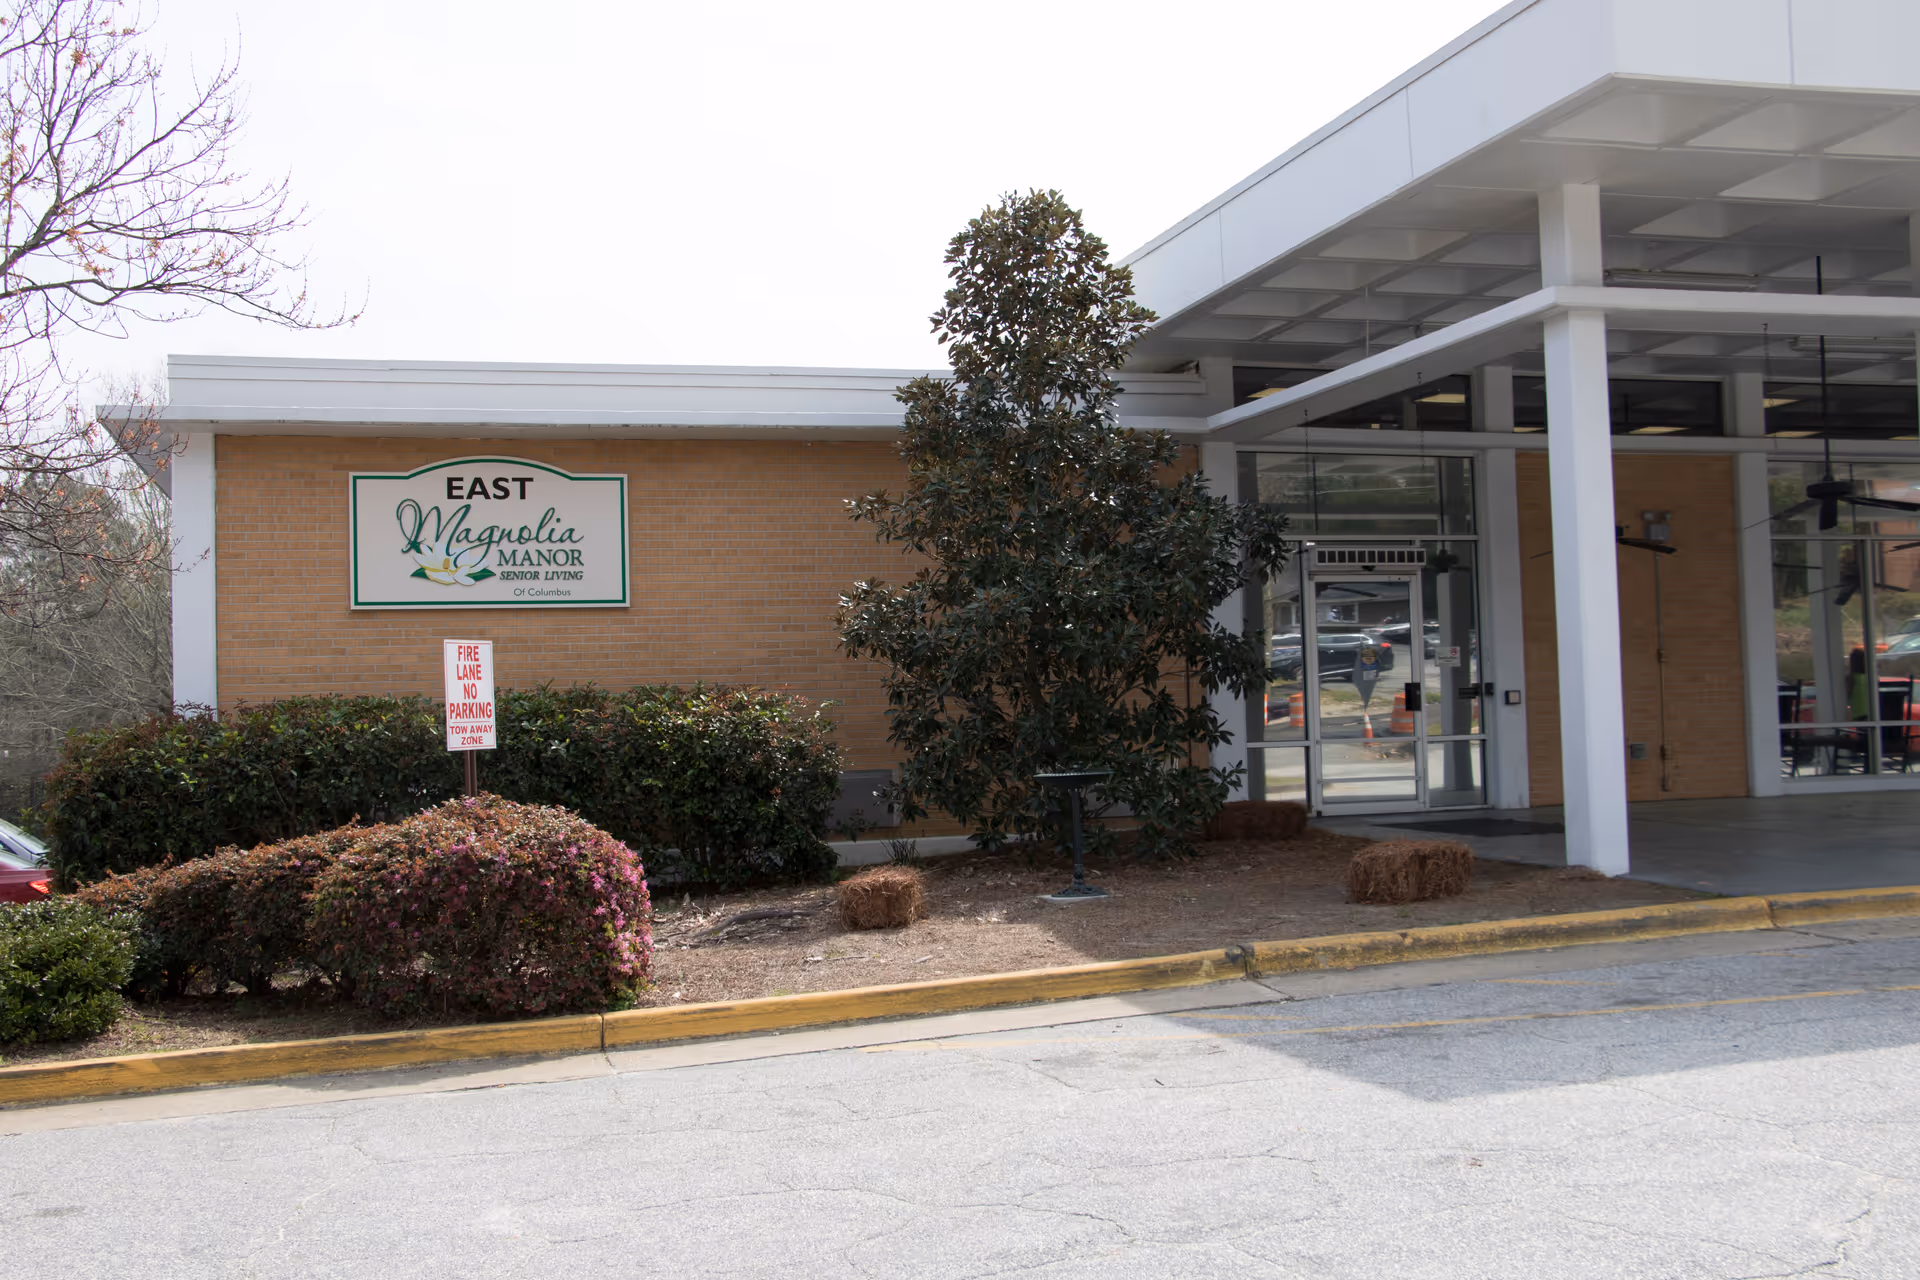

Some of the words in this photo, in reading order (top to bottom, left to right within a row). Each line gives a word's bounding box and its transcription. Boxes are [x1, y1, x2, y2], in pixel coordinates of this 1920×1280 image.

[446, 477, 534, 499] EAST
[396, 498, 584, 569] Magnolia
[497, 549, 584, 566] MANOR
[500, 570, 540, 580] SENIOR
[544, 570, 584, 580] LIVING
[513, 587, 526, 597] Of
[528, 587, 571, 597] Columbus
[457, 645, 480, 661] FIRE
[456, 664, 482, 680] LANE
[463, 683, 477, 699] NO
[449, 702, 492, 719] PARKING
[450, 725, 468, 735] TOW
[469, 724, 493, 734] AWAY
[461, 736, 483, 745] ZONE
